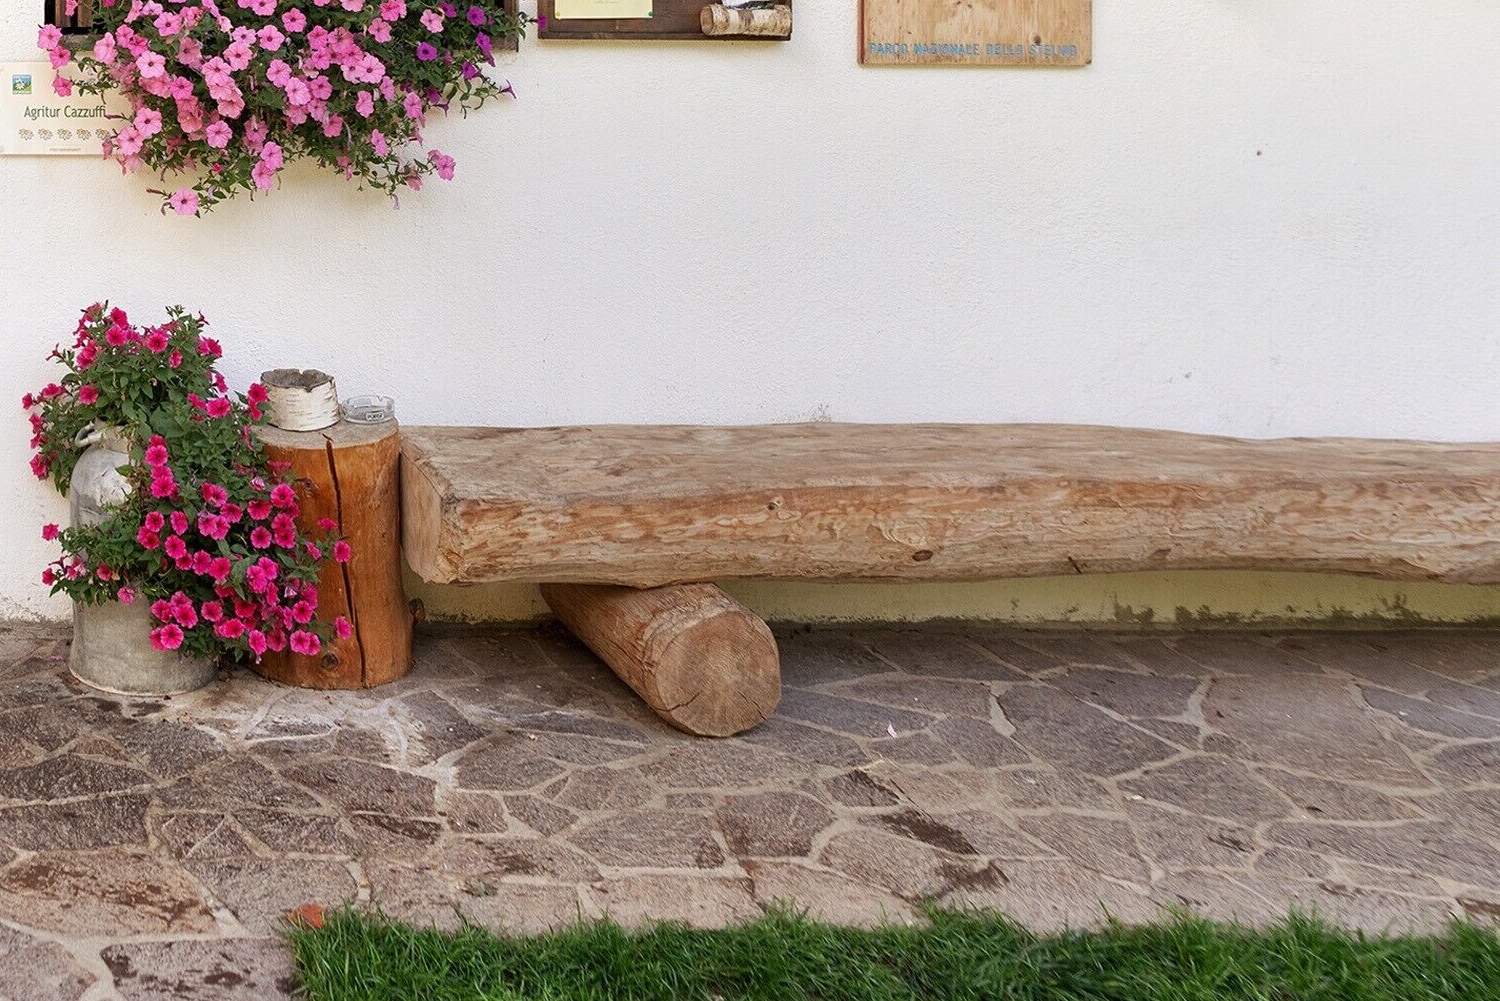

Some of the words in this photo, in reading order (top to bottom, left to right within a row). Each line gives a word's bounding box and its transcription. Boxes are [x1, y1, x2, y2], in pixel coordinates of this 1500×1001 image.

[867, 43, 908, 56] PARCO
[23, 106, 60, 121] Agritur
[64, 105, 106, 118] Cazzuffi
